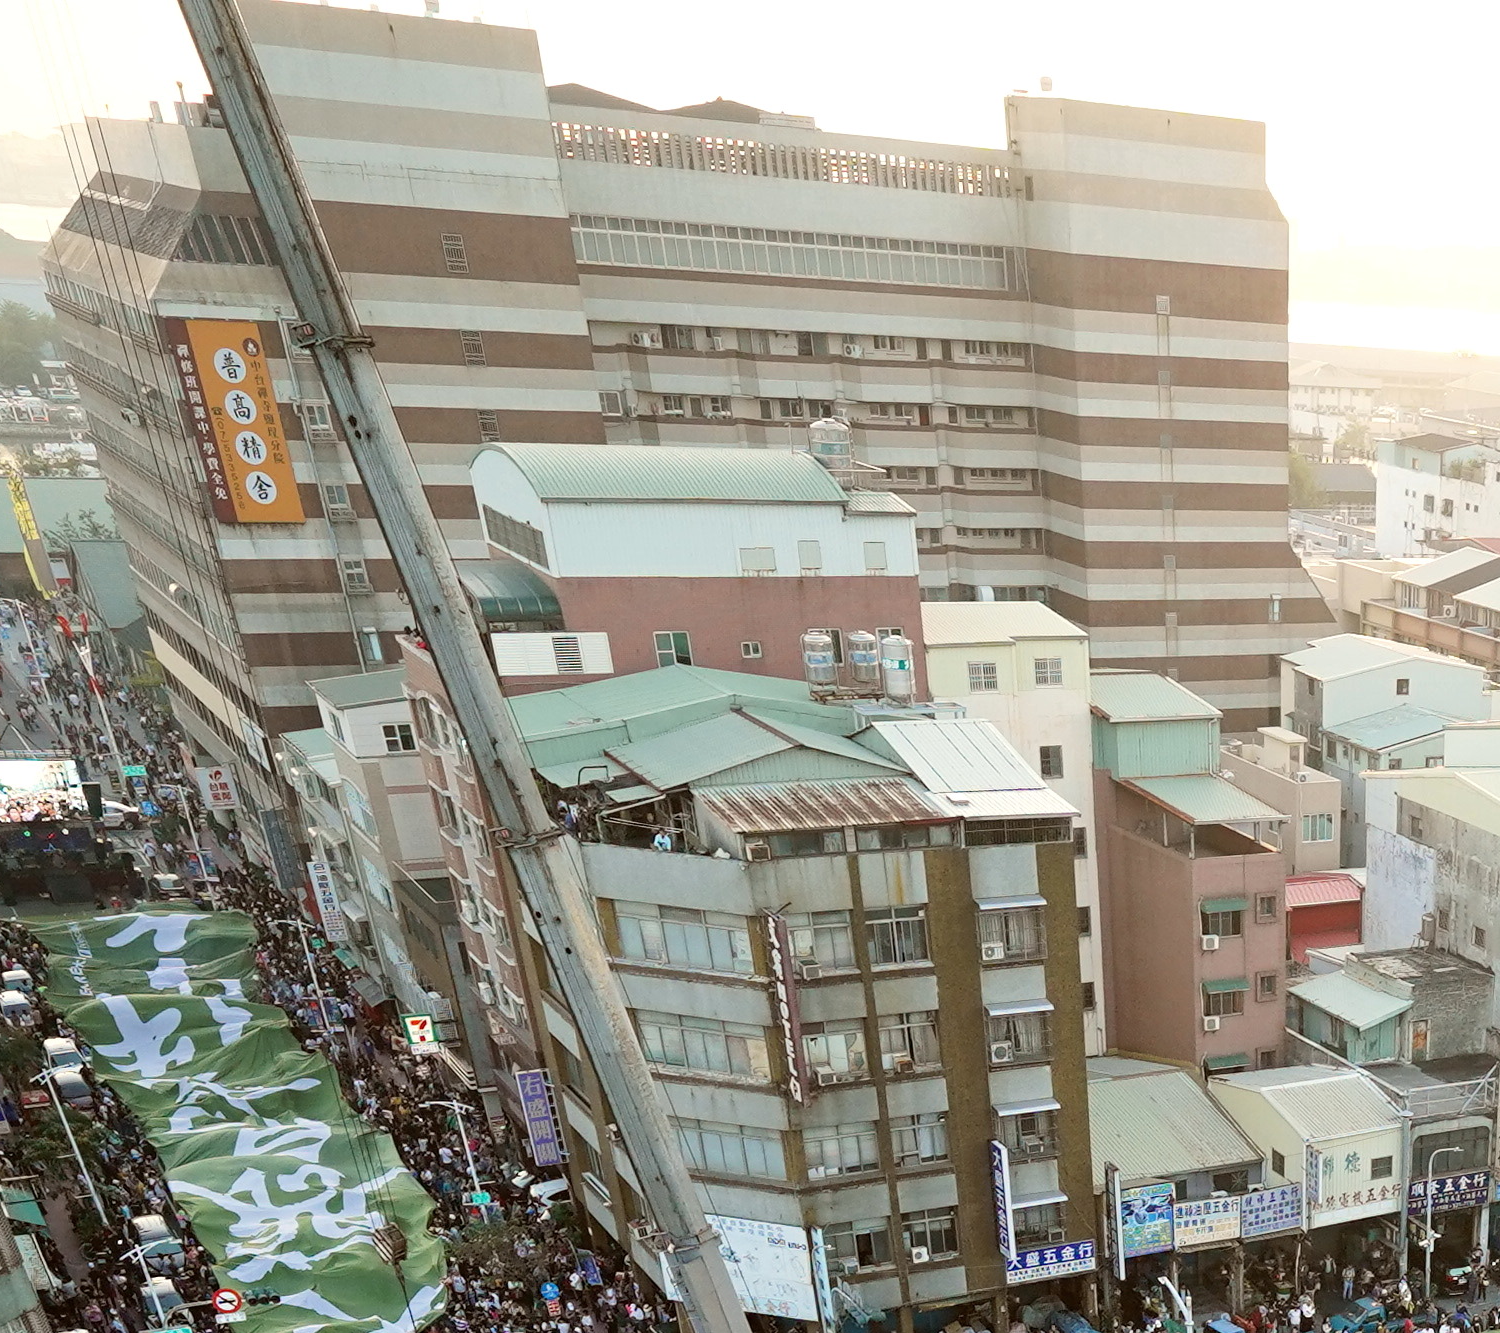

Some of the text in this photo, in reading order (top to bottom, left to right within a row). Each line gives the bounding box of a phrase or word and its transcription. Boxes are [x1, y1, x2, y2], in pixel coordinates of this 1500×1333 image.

[221, 352, 272, 500] 普高精舍
[1008, 1242, 1094, 1271] 大盛五金行
